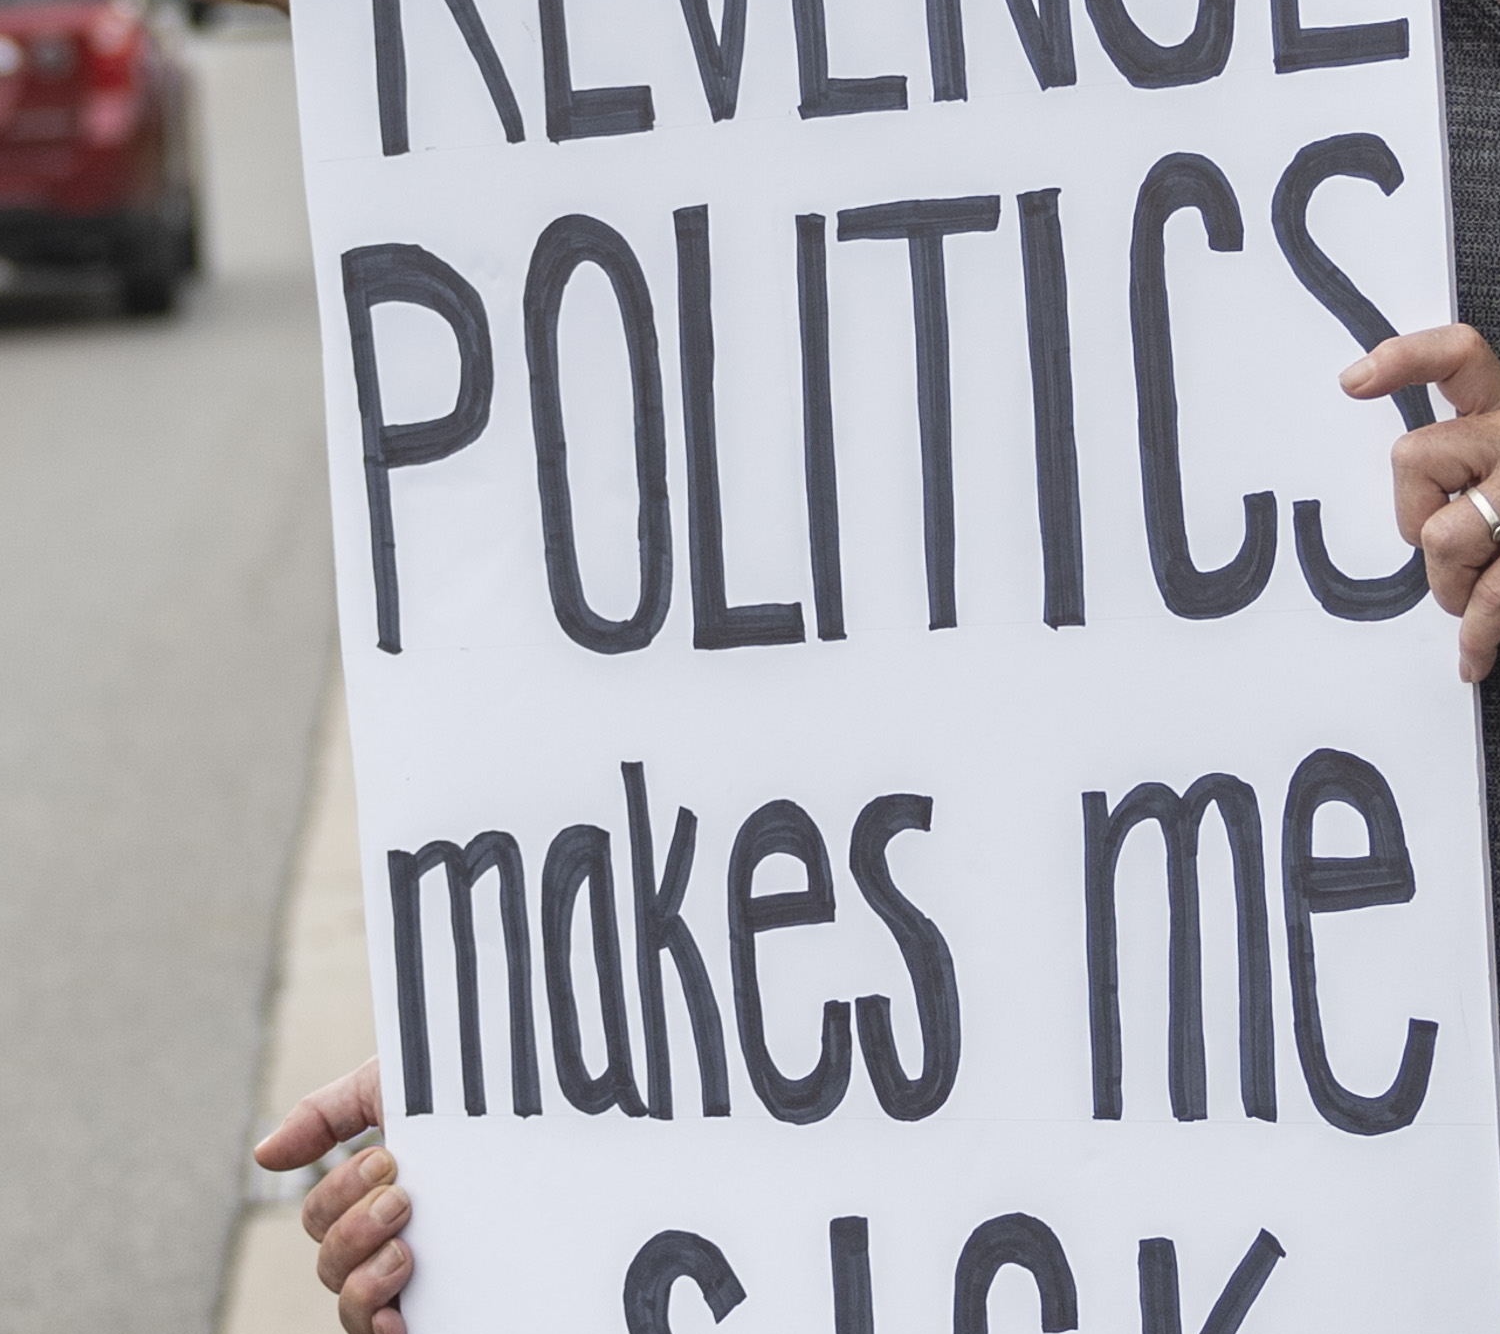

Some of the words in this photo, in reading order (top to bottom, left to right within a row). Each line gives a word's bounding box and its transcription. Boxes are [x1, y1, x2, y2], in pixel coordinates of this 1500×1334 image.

[340, 132, 1434, 655] POLITICS
[387, 760, 962, 1126] makes
[1081, 747, 1440, 1137] me
